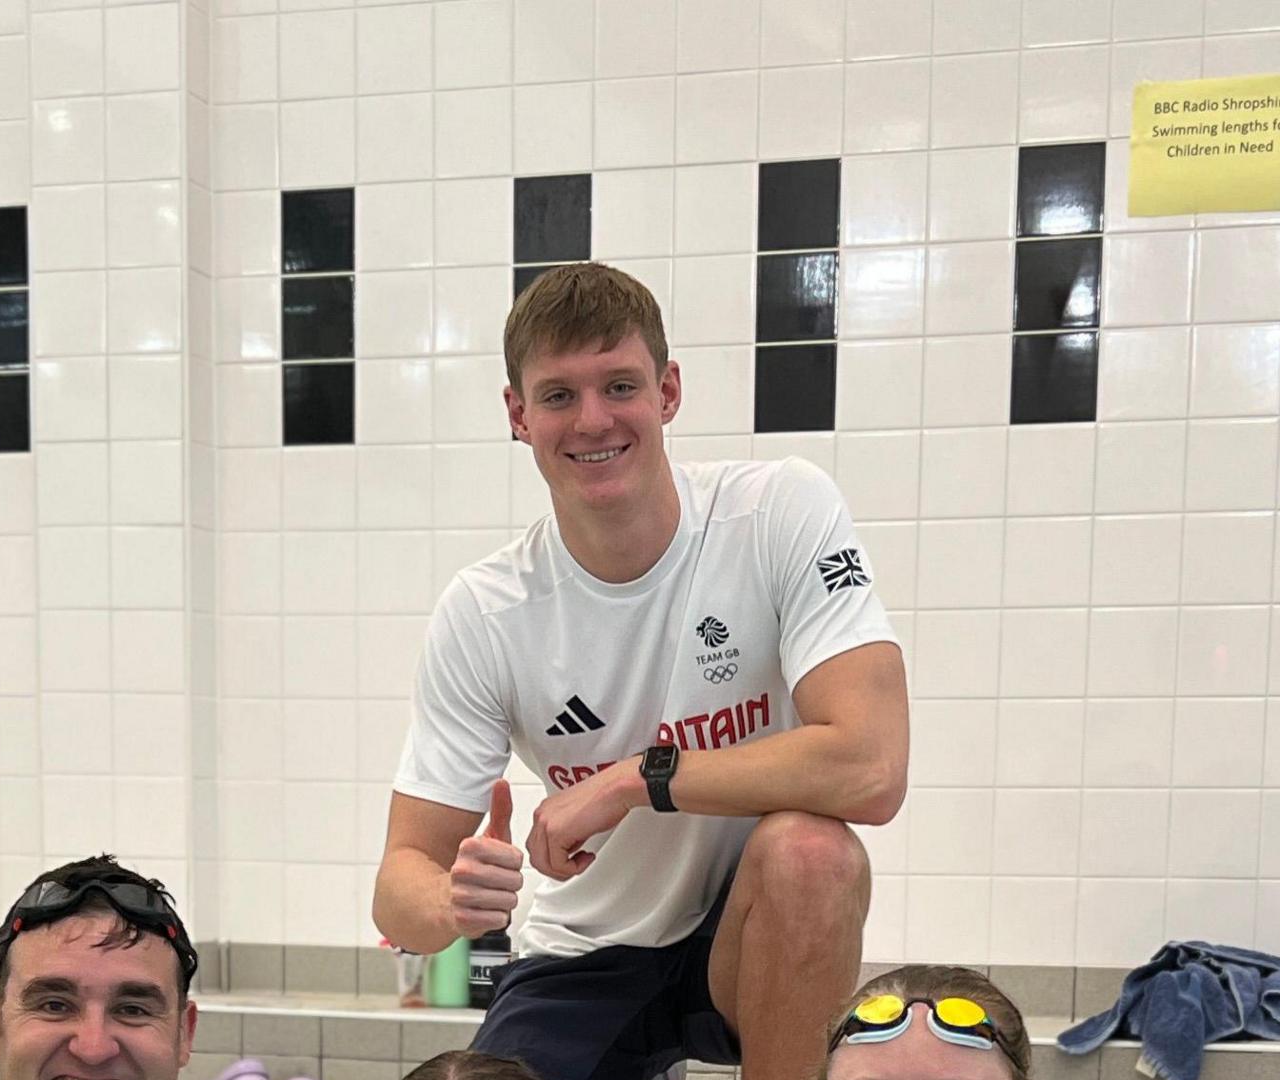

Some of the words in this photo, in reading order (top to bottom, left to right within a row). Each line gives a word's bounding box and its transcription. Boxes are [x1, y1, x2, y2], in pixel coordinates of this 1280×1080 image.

[1154, 101, 1180, 114] BBC
[1183, 98, 1219, 112] Radio
[1152, 122, 1218, 138] Swimming
[1221, 119, 1269, 136] lengths
[1166, 144, 1220, 158] Children
[1224, 142, 1236, 154] in
[1239, 140, 1274, 154] Need
[696, 651, 724, 665] TEAM
[724, 647, 740, 660] GB
